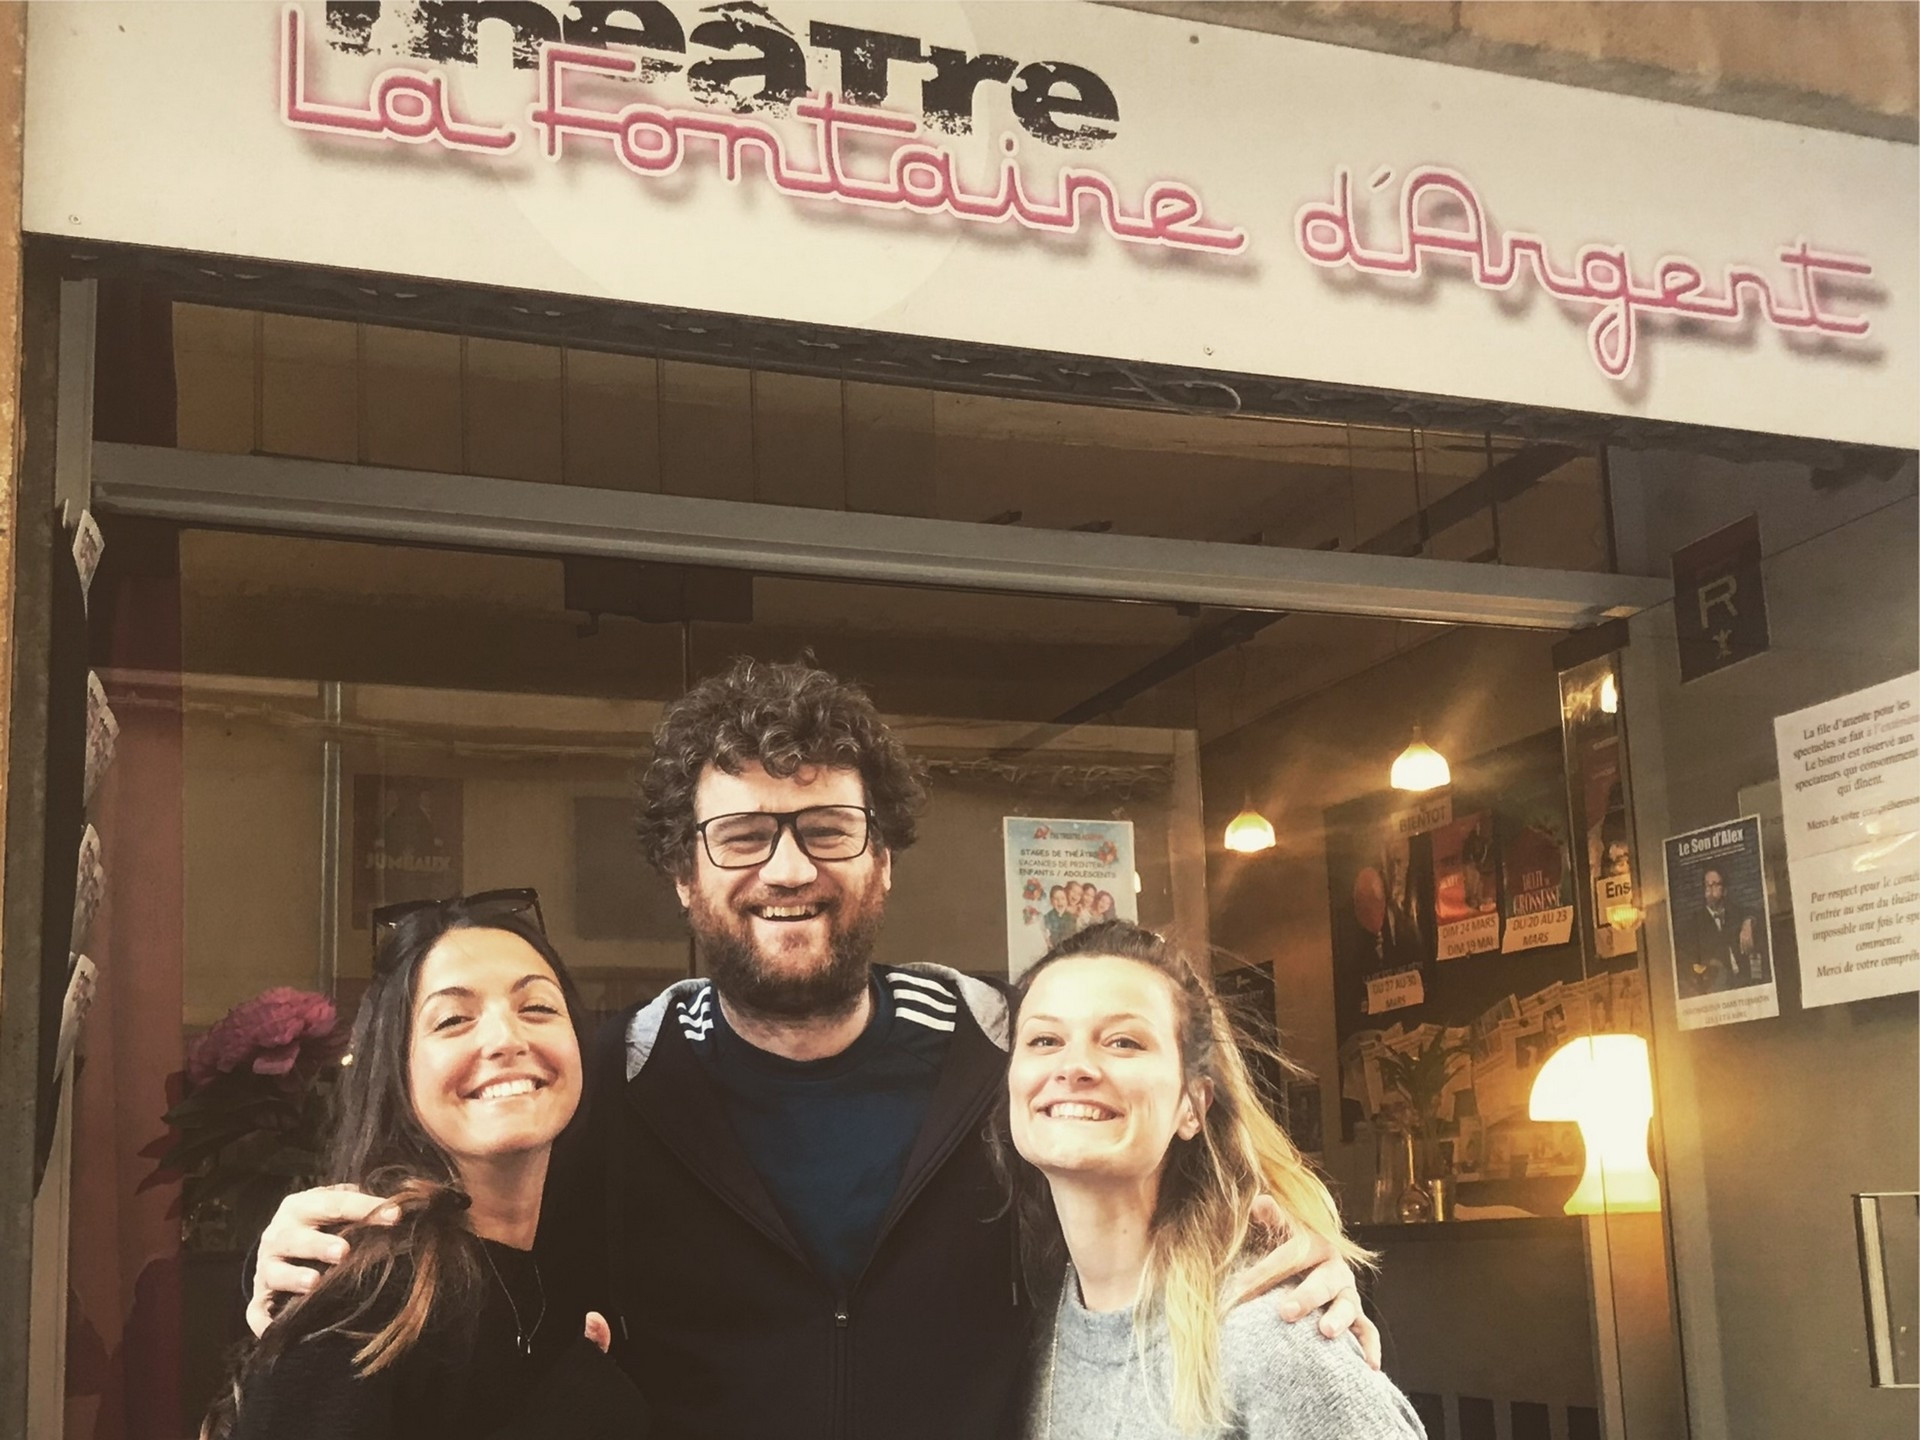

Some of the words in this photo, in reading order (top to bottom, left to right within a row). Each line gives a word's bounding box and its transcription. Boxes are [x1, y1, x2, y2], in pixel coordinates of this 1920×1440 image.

[280, 1, 517, 156] La
[532, 39, 1247, 257] Fontaine
[1294, 165, 1873, 379] d'Argent
[1803, 729, 1815, 740] La
[1874, 705, 1894, 721] pour
[1897, 700, 1911, 711] les
[1793, 740, 1836, 760] spectacles
[1838, 736, 1847, 745] se
[1849, 730, 1864, 742] fait
[1805, 761, 1816, 771] Le
[1818, 752, 1845, 767] bistrot
[1847, 748, 1861, 759] est
[1897, 733, 1914, 745] aux
[1795, 771, 1841, 792] spectateurs
[1843, 766, 1857, 779] qui
[1837, 784, 1851, 797] qui
[1830, 815, 1840, 826] de
[1020, 849, 1050, 857] STAGES
[1052, 849, 1062, 858] DE
[1679, 842, 1690, 857] Le
[1691, 838, 1711, 853] Son
[1712, 828, 1744, 848] d'Alex
[1019, 869, 1055, 877] ENFANTS
[1058, 860, 1068, 868] DE
[1811, 892, 1826, 904] Par
[1828, 885, 1858, 901] respect
[1860, 881, 1880, 896] pour
[1883, 876, 1890, 888] le
[1843, 906, 1854, 915] au
[1877, 897, 1888, 909] du
[1442, 925, 1459, 939] DIM
[1471, 916, 1496, 932] MARS
[1512, 919, 1526, 931] DU
[1527, 916, 1539, 928] 20
[1540, 912, 1554, 925] AU
[1556, 910, 1568, 923] 23
[1812, 922, 1856, 942] impossible
[1859, 920, 1875, 932] une
[1876, 915, 1893, 933] fois
[1895, 913, 1904, 925] le
[1522, 932, 1549, 946] MARS
[1816, 965, 1842, 978] Merci
[1844, 961, 1853, 973] de
[1856, 958, 1879, 970] votre
